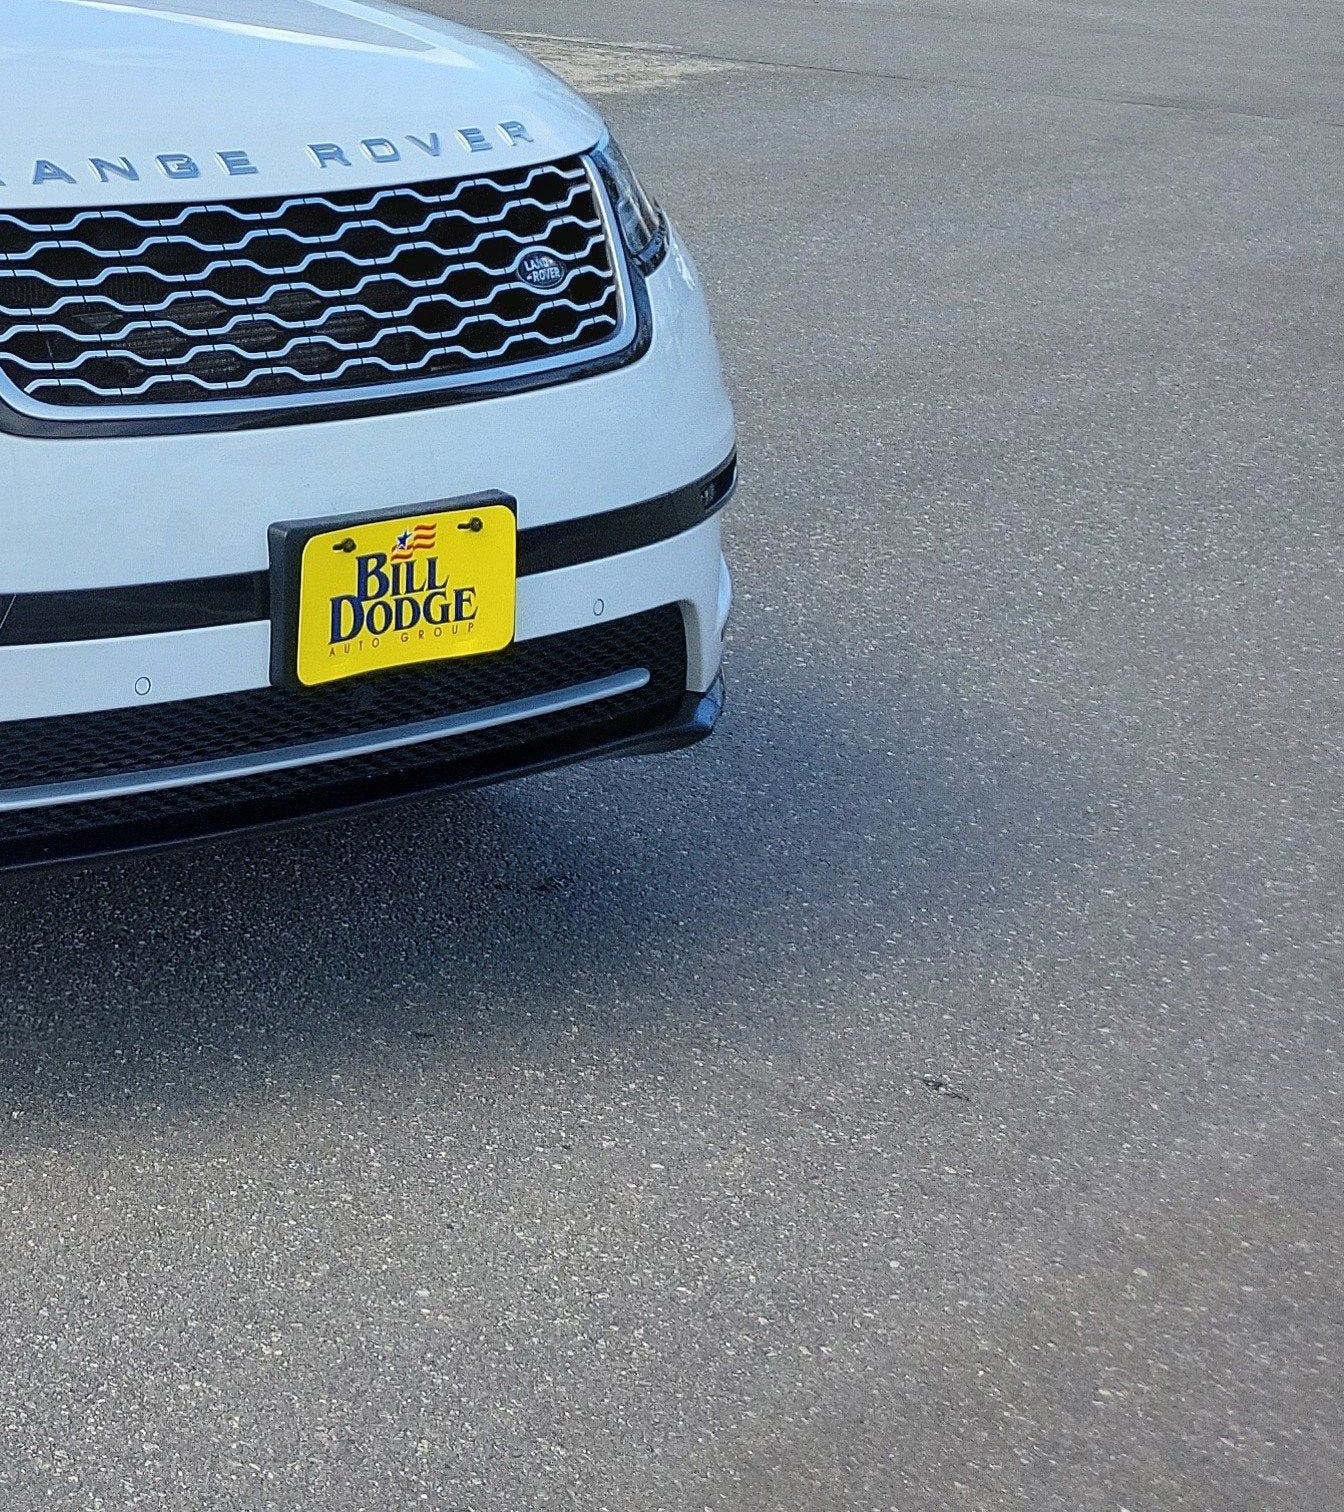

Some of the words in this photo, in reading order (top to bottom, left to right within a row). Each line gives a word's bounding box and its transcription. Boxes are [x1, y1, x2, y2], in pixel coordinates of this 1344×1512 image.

[304, 120, 535, 169] ROVER
[531, 266, 561, 283] ROVER
[355, 552, 450, 602] BILL
[328, 586, 479, 646] DODGE
[328, 637, 380, 658] AUTO
[400, 622, 475, 643] GROUP
